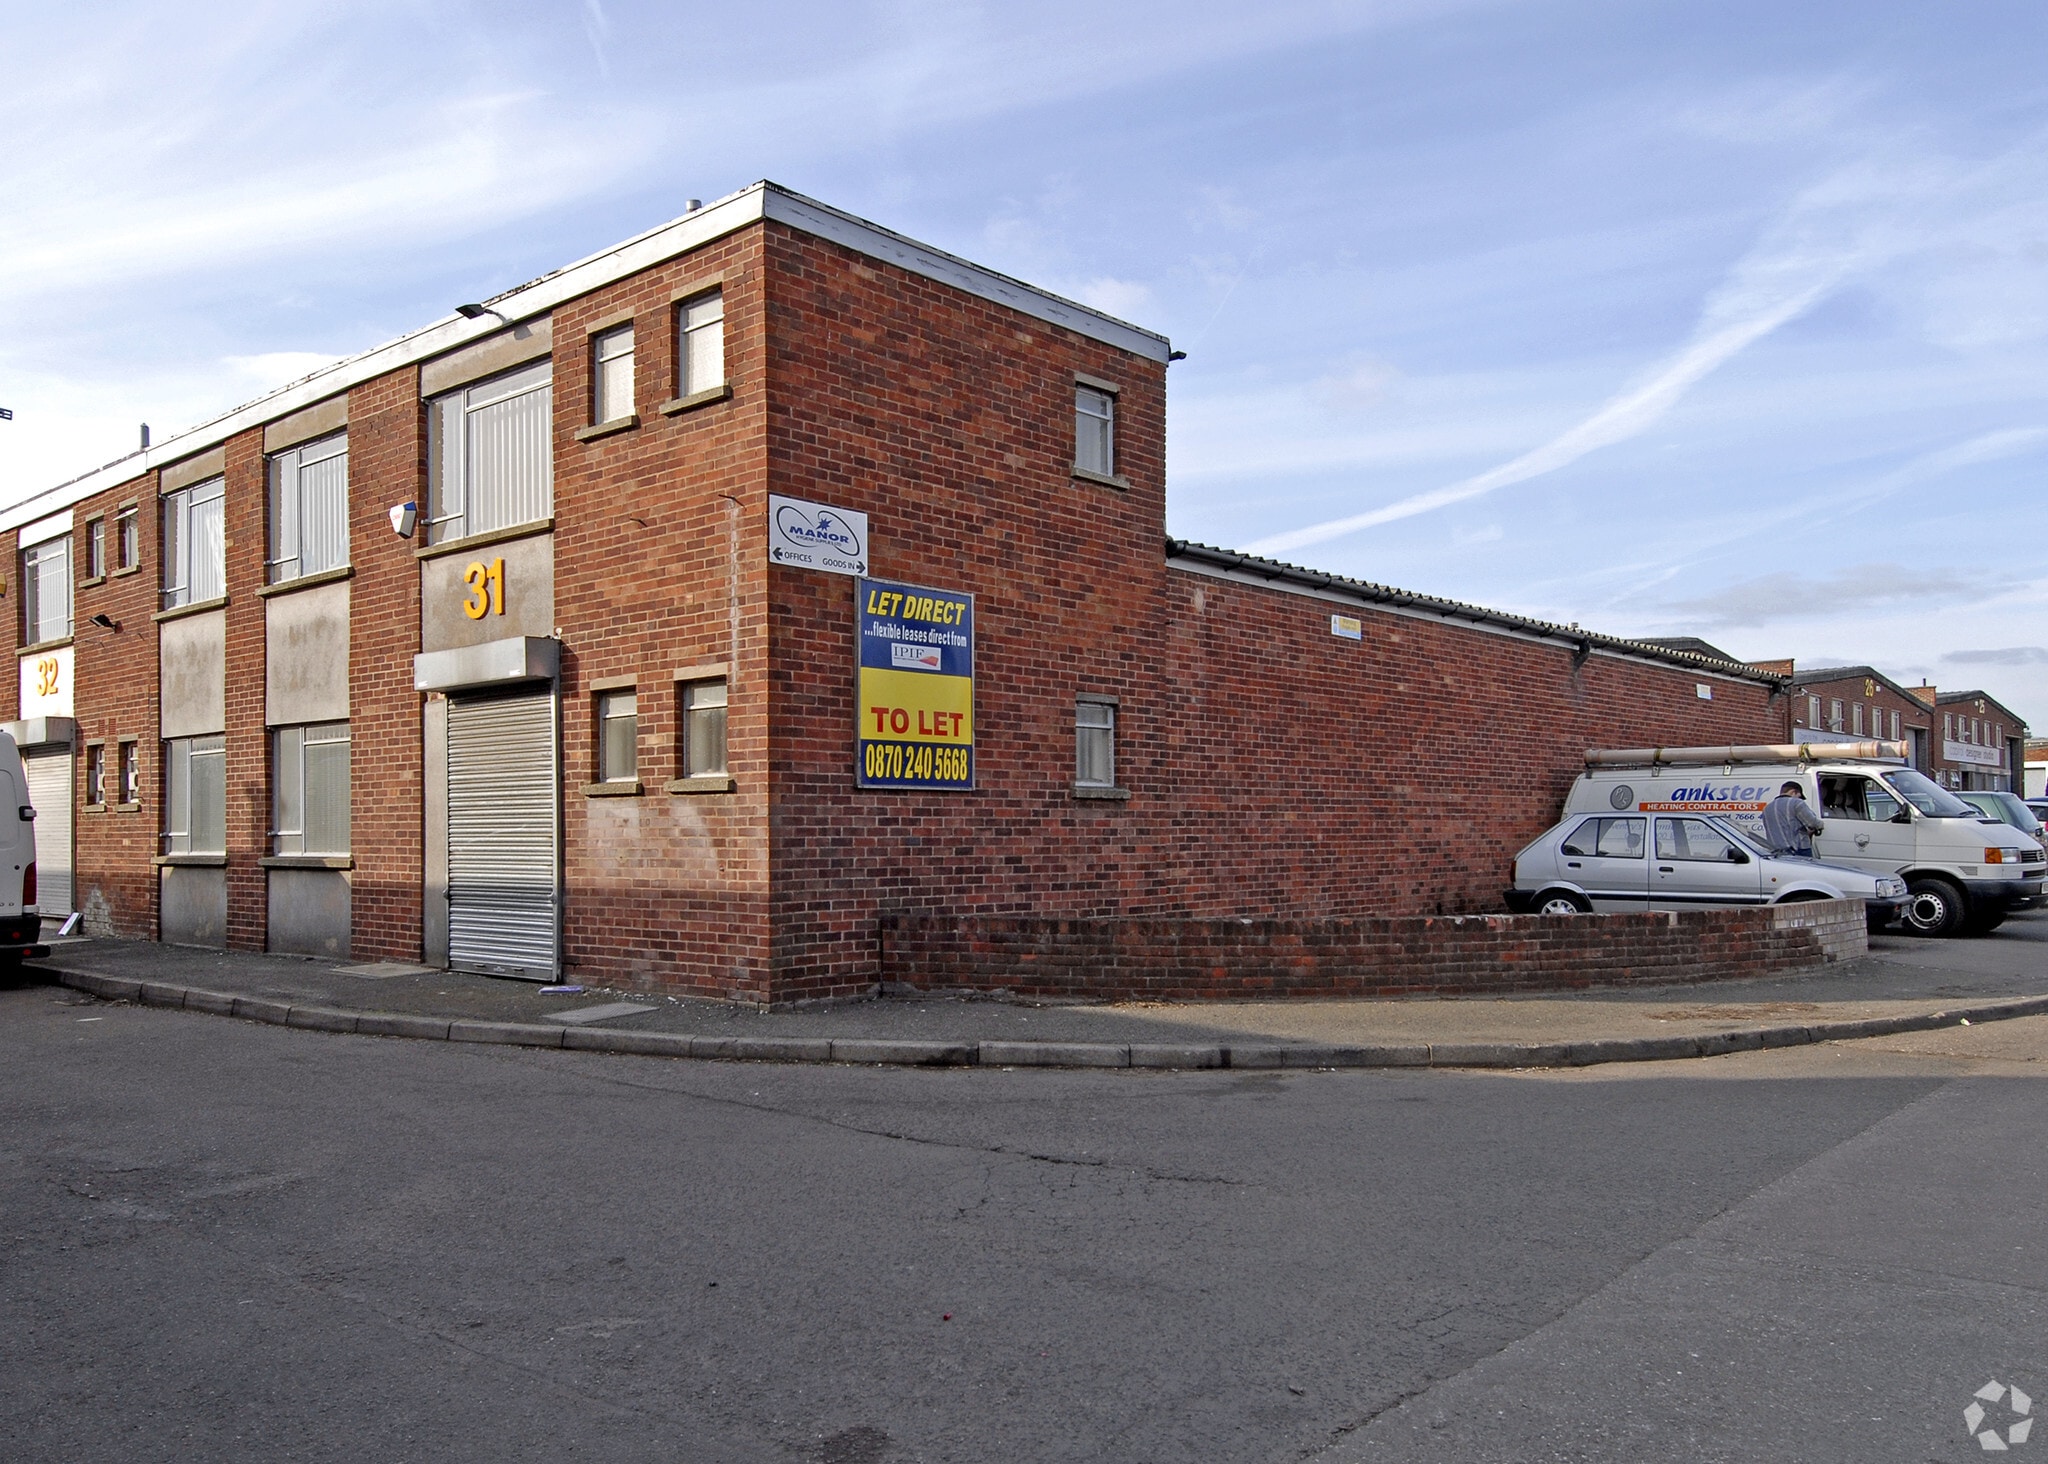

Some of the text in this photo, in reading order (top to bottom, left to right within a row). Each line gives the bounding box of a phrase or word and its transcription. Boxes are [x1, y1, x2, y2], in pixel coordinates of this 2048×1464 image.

[789, 526, 849, 544] MANOR
[784, 551, 855, 570] OFFICES GOODS IN
[463, 557, 506, 620] 31
[867, 590, 966, 625] LET DIRECT
[902, 625, 928, 643] leases
[928, 628, 950, 646] direct
[951, 631, 967, 647] from
[894, 646, 925, 658] IPIF
[37, 658, 58, 697] 32
[1864, 678, 1874, 697] 26
[871, 707, 964, 737] TO LET
[865, 743, 967, 781] 0870 240 5668
[1671, 783, 1770, 801] ankster
[1648, 803, 1758, 811] HEATING CONTRACTORS
